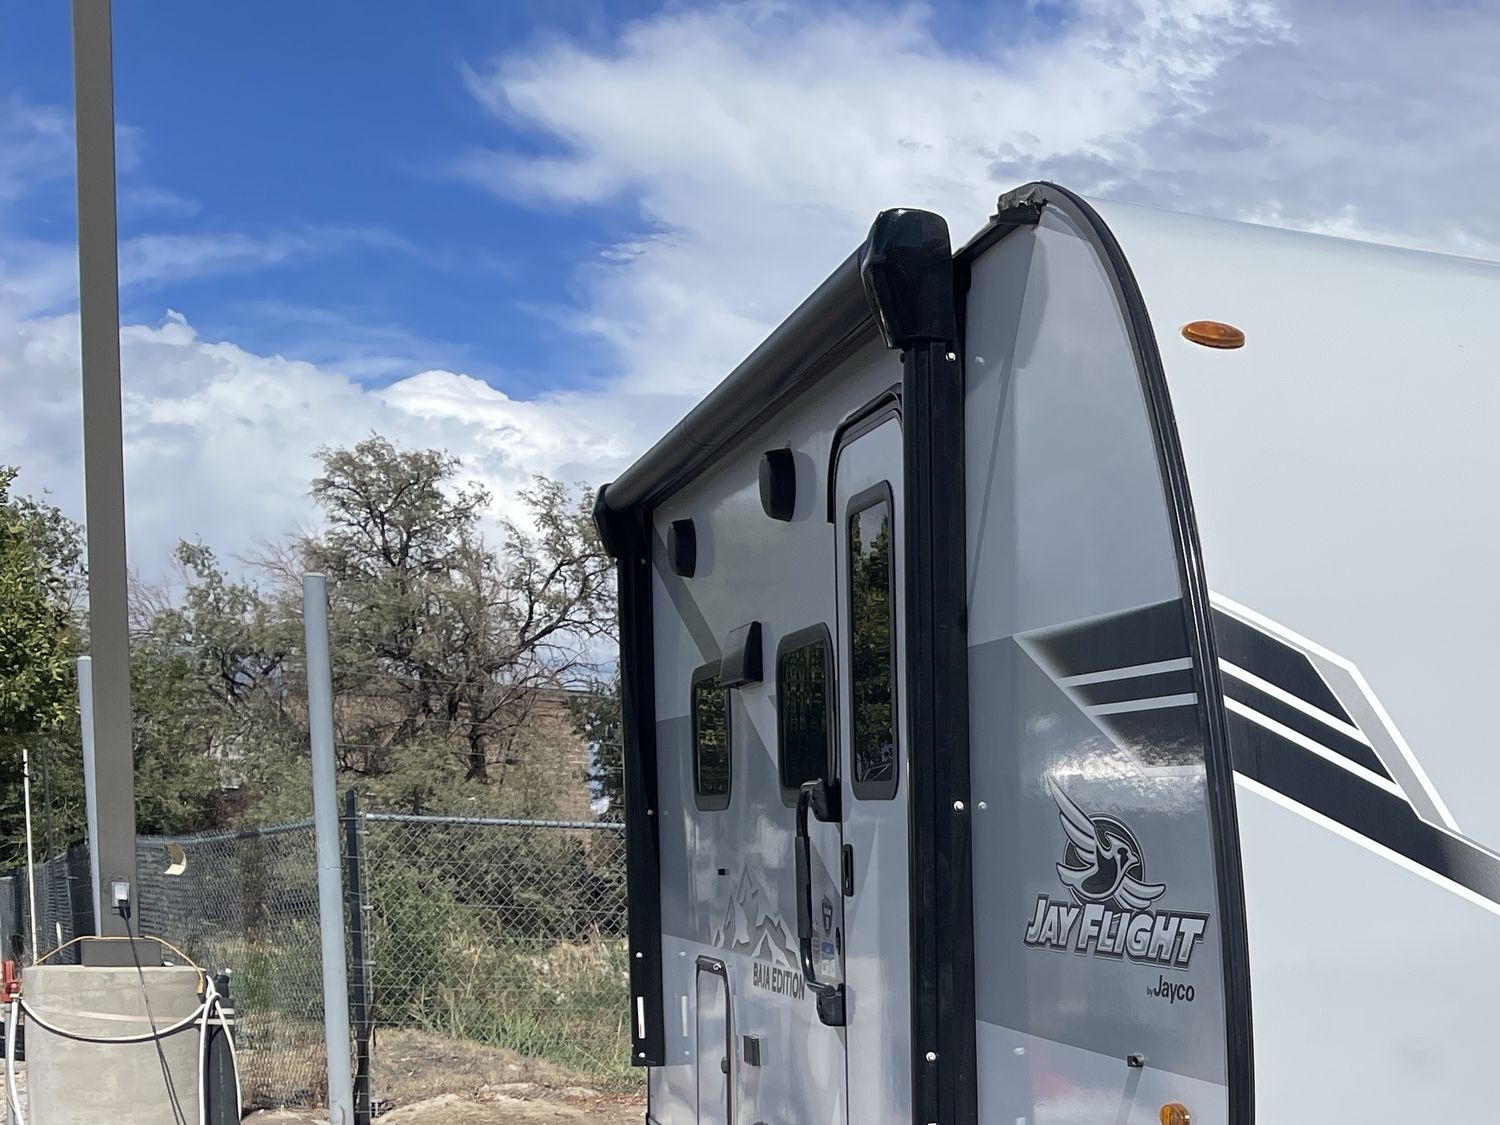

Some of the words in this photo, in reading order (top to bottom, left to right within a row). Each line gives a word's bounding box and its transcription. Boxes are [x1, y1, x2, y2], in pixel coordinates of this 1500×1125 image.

[1024, 893, 1083, 953] JAY
[1074, 903, 1210, 971] FLIGHT
[753, 962, 770, 991] BAJA
[771, 967, 805, 1001] EDITION
[1153, 975, 1195, 1004] Jayco
